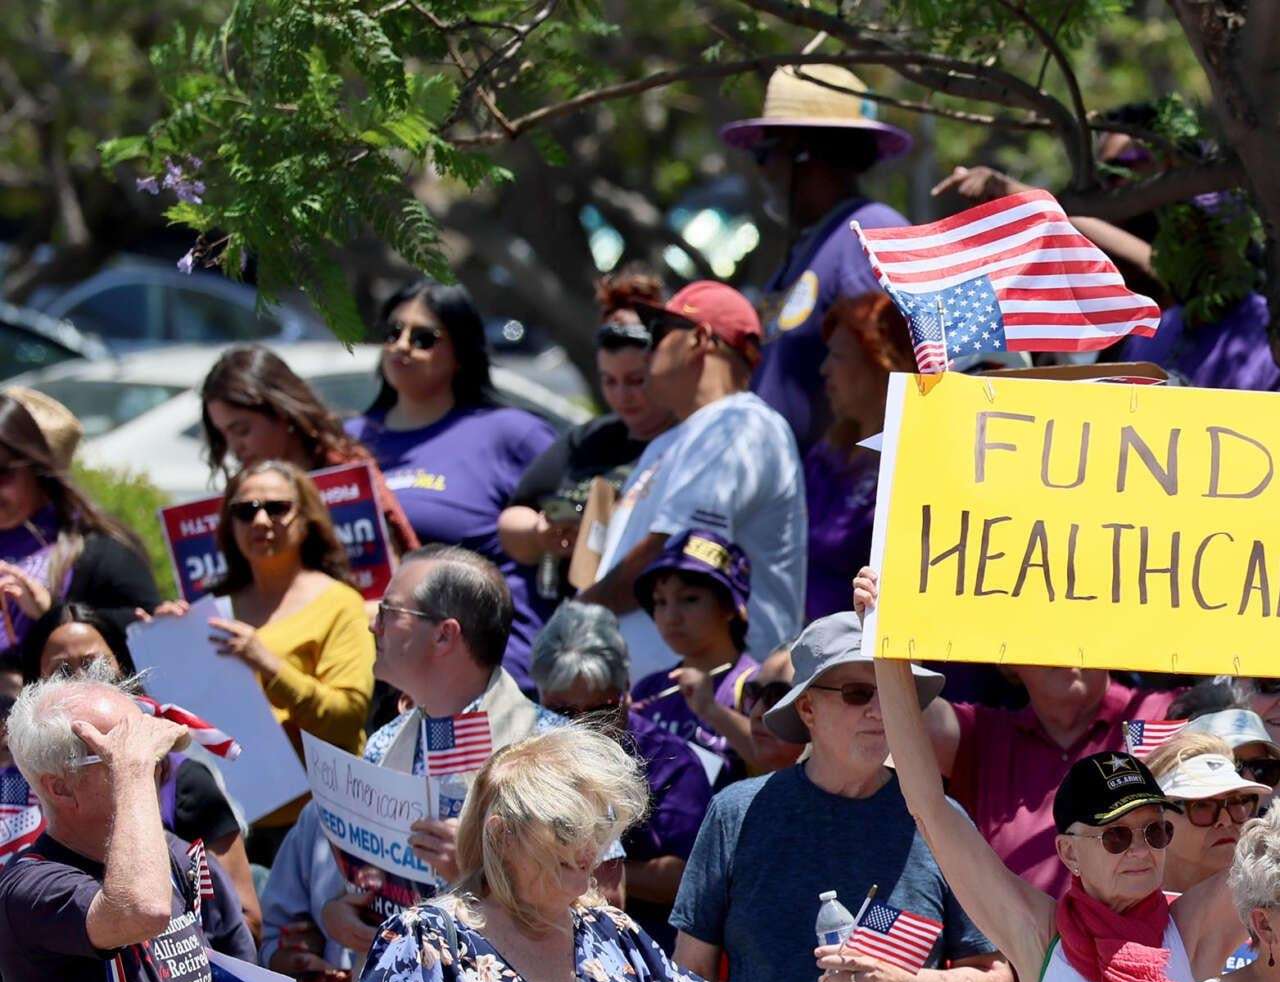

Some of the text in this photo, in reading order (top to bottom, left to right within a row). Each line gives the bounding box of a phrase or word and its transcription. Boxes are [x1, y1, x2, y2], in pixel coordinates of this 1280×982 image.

[974, 411, 1274, 499] FUND
[346, 764, 424, 821] Americans
[321, 805, 347, 839] EED
[153, 933, 199, 961] Alliance
